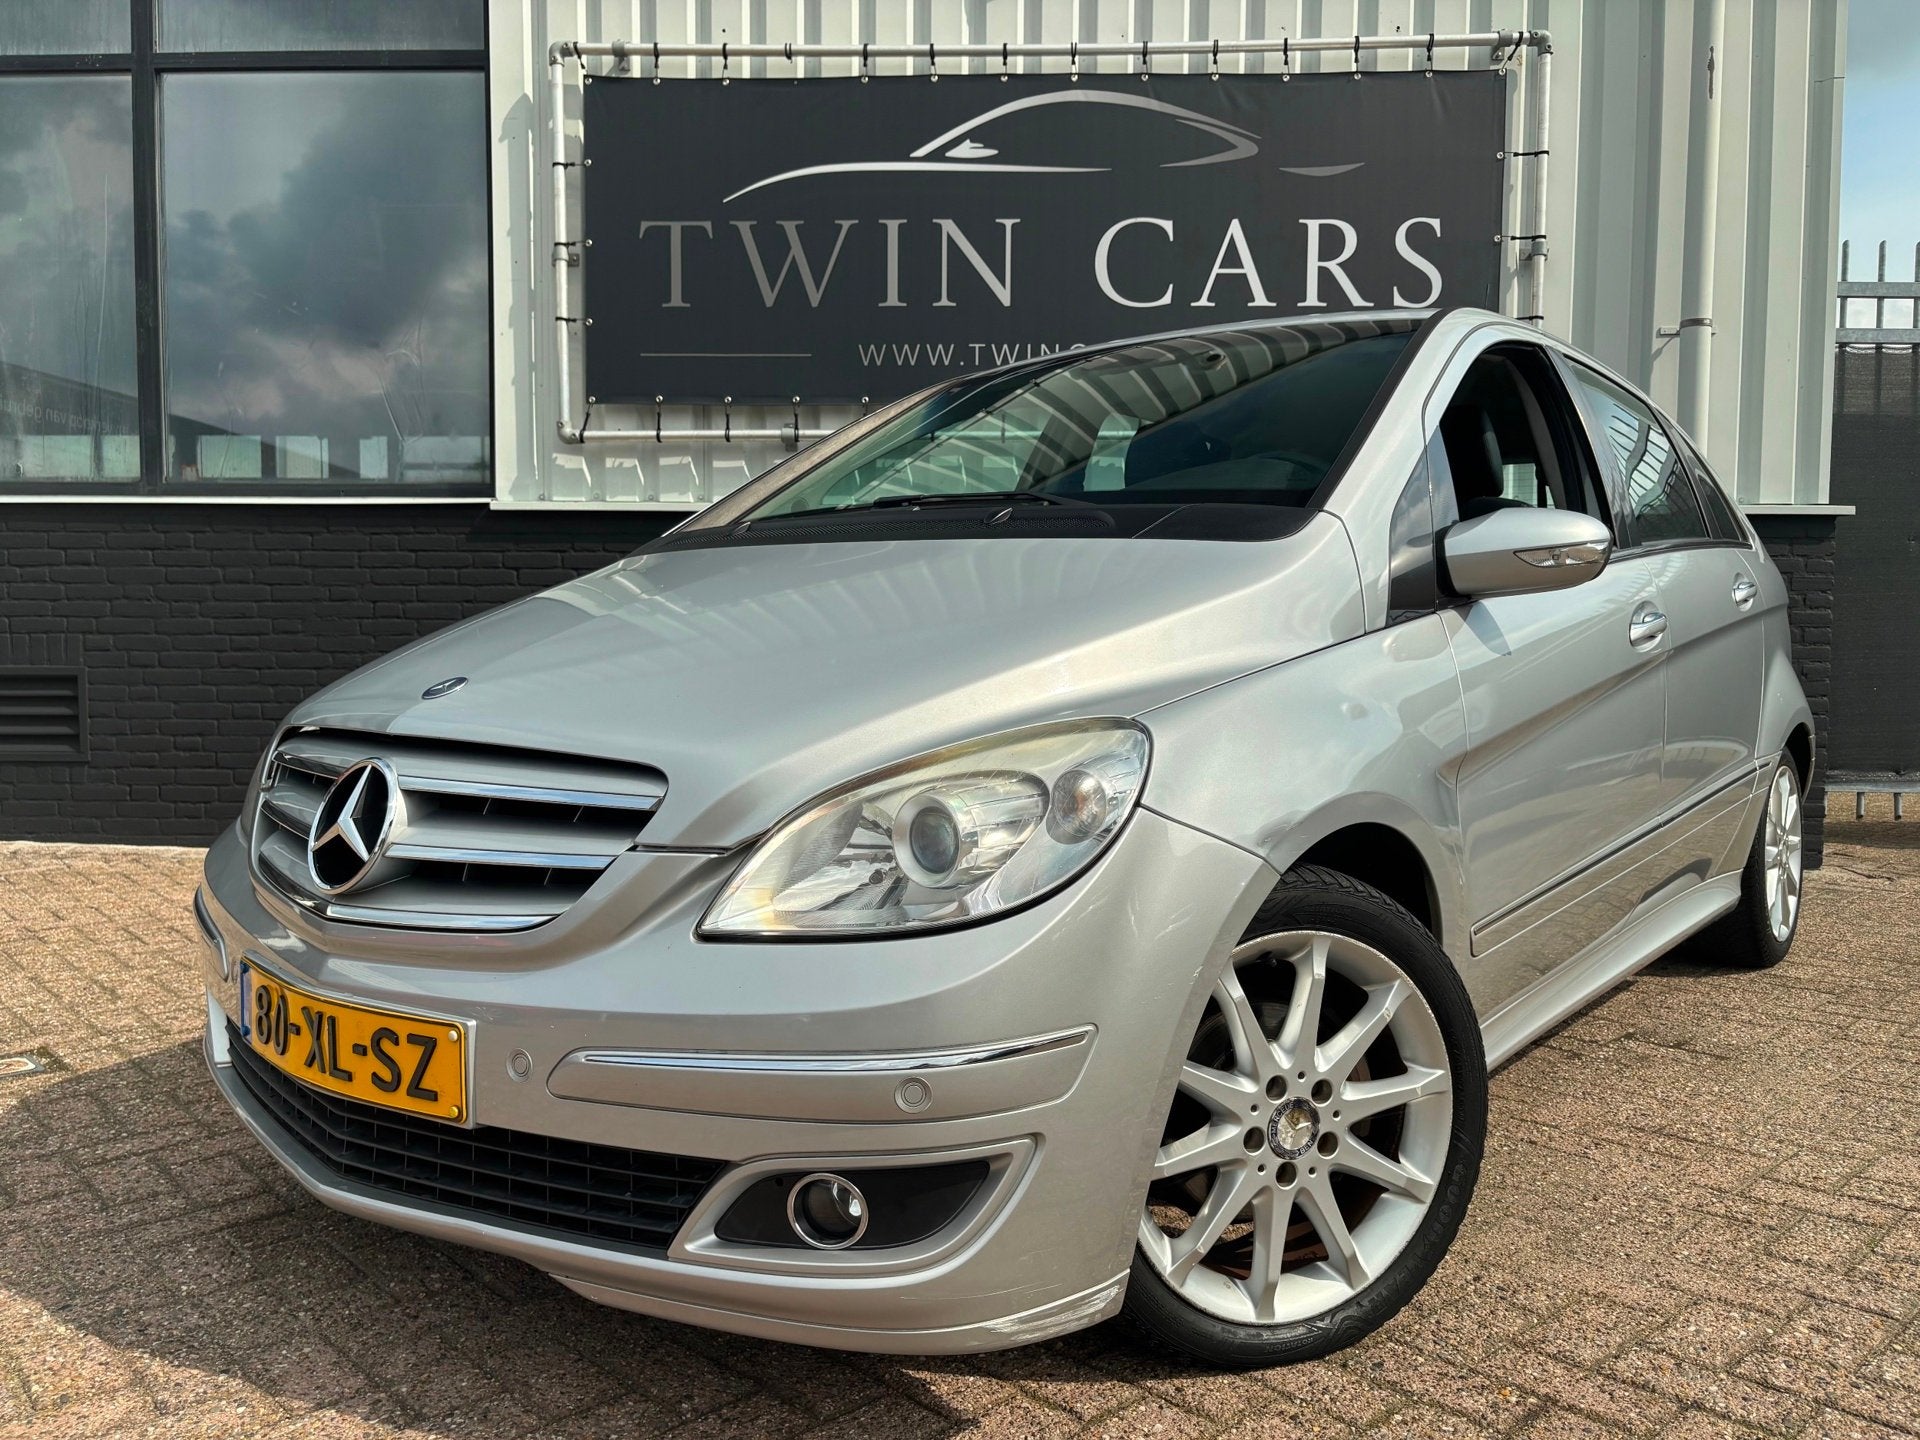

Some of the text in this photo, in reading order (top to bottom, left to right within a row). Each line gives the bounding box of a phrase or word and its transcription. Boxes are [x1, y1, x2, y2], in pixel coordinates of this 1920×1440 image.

[640, 216, 1443, 308] TWIN CARS
[858, 343, 1087, 367] WWW.TWIN
[255, 984, 438, 1101] 80-XL-SZ
